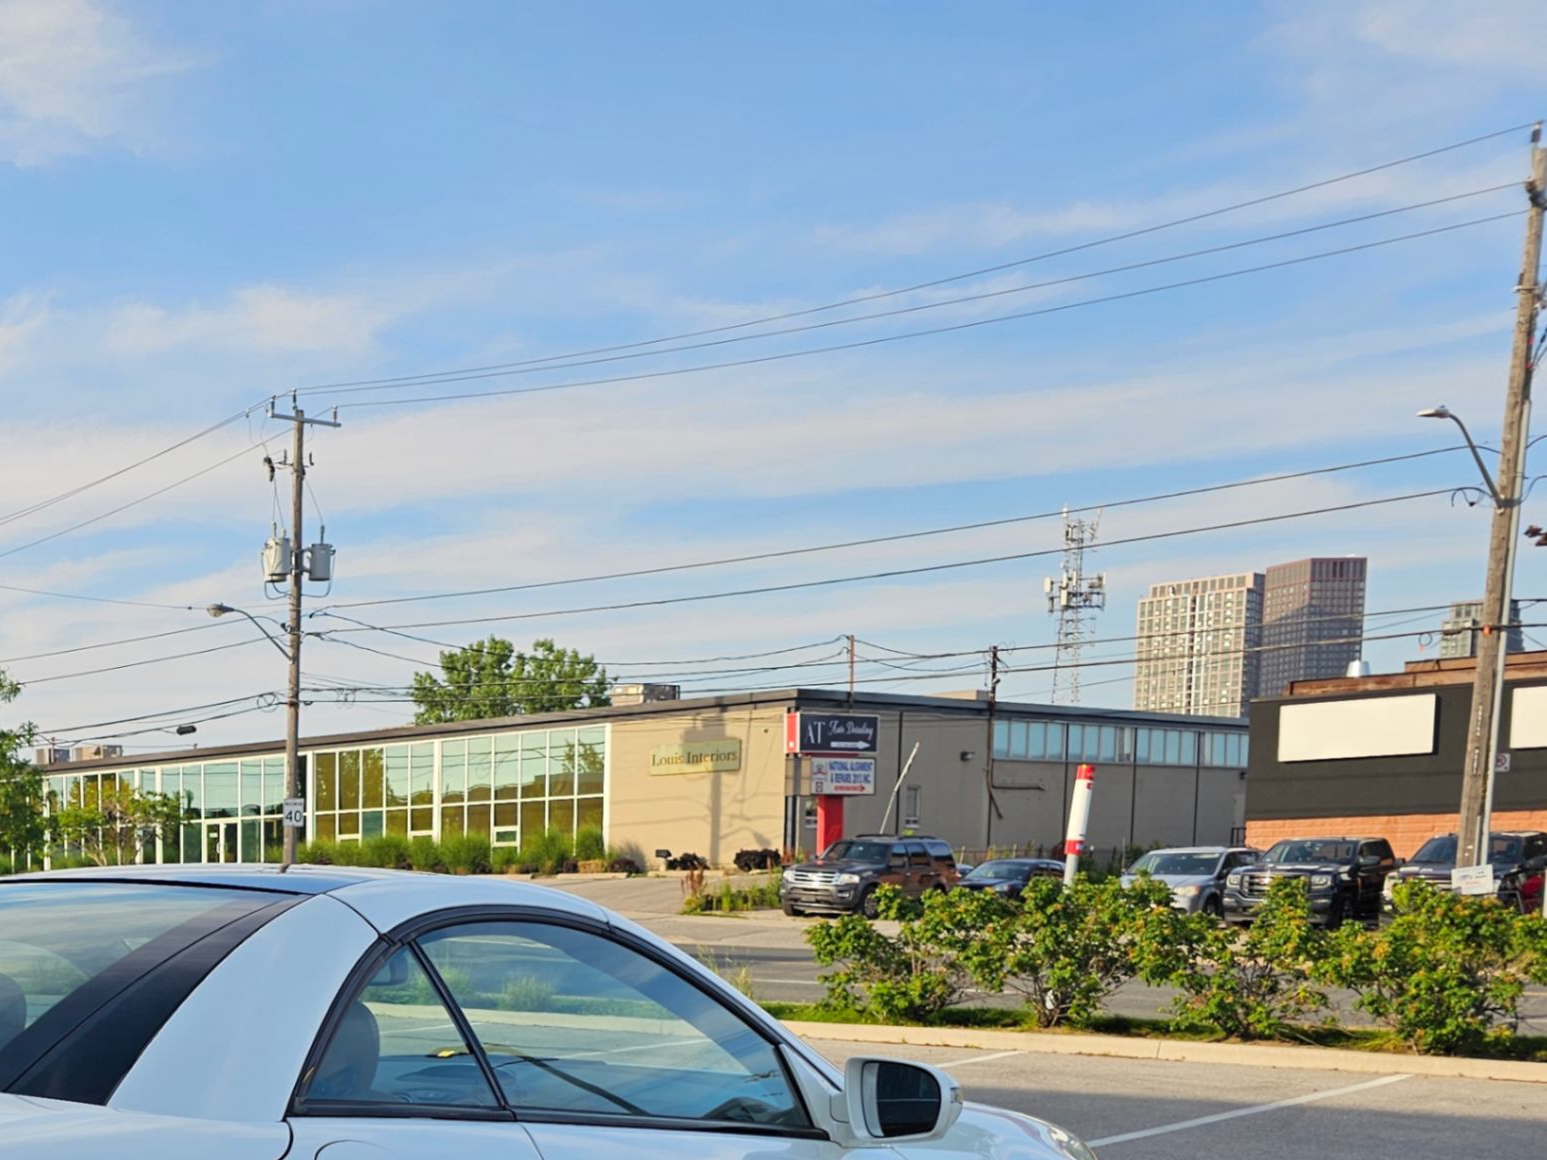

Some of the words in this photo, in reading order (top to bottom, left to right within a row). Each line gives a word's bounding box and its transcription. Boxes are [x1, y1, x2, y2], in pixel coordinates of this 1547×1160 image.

[805, 721, 826, 744] AT
[652, 752, 684, 766] Louis
[687, 749, 737, 764] Interiors
[285, 810, 302, 822] 40
